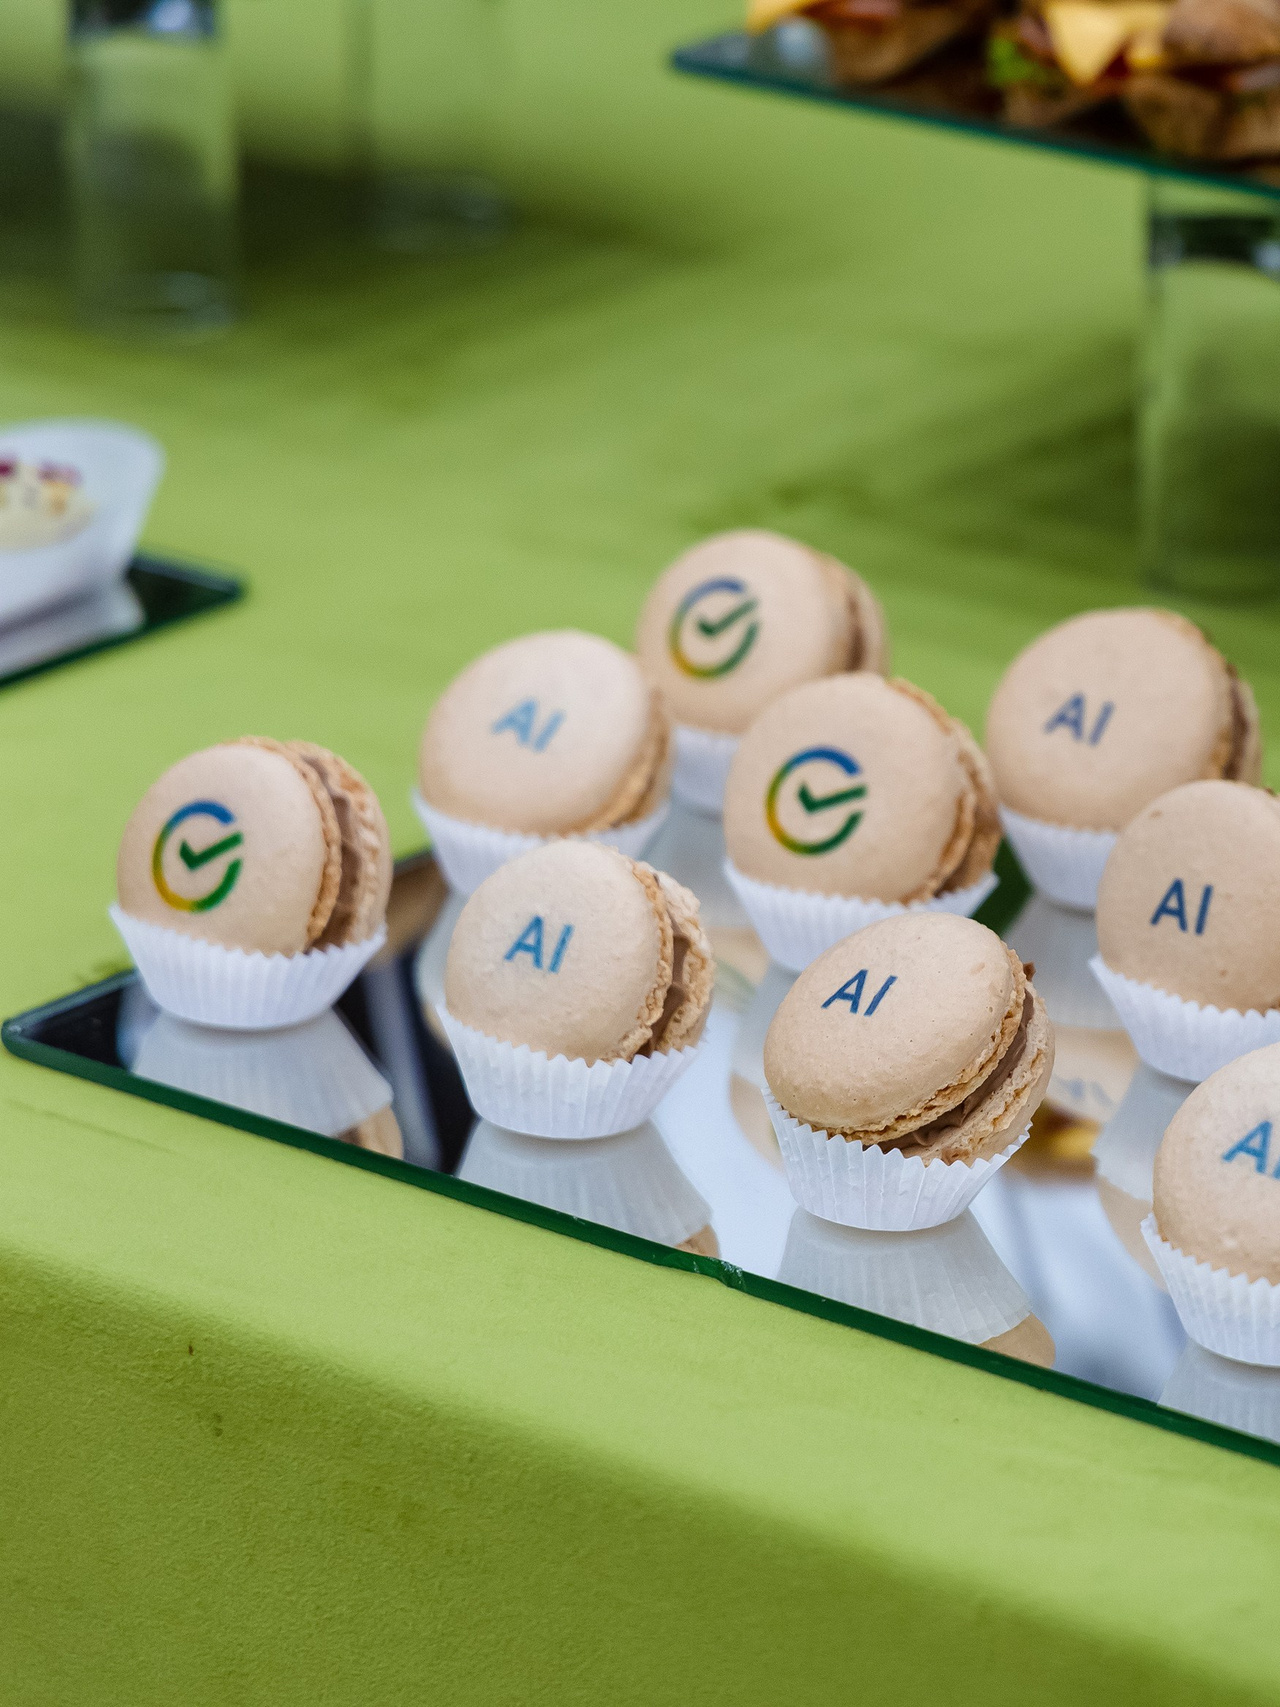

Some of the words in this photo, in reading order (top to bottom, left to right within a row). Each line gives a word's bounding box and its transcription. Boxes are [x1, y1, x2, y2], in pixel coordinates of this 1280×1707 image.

[490, 698, 564, 752] AI
[1045, 693, 1115, 744] AI
[1150, 878, 1215, 936] AI
[503, 914, 573, 973] AI
[820, 967, 898, 1017] AI
